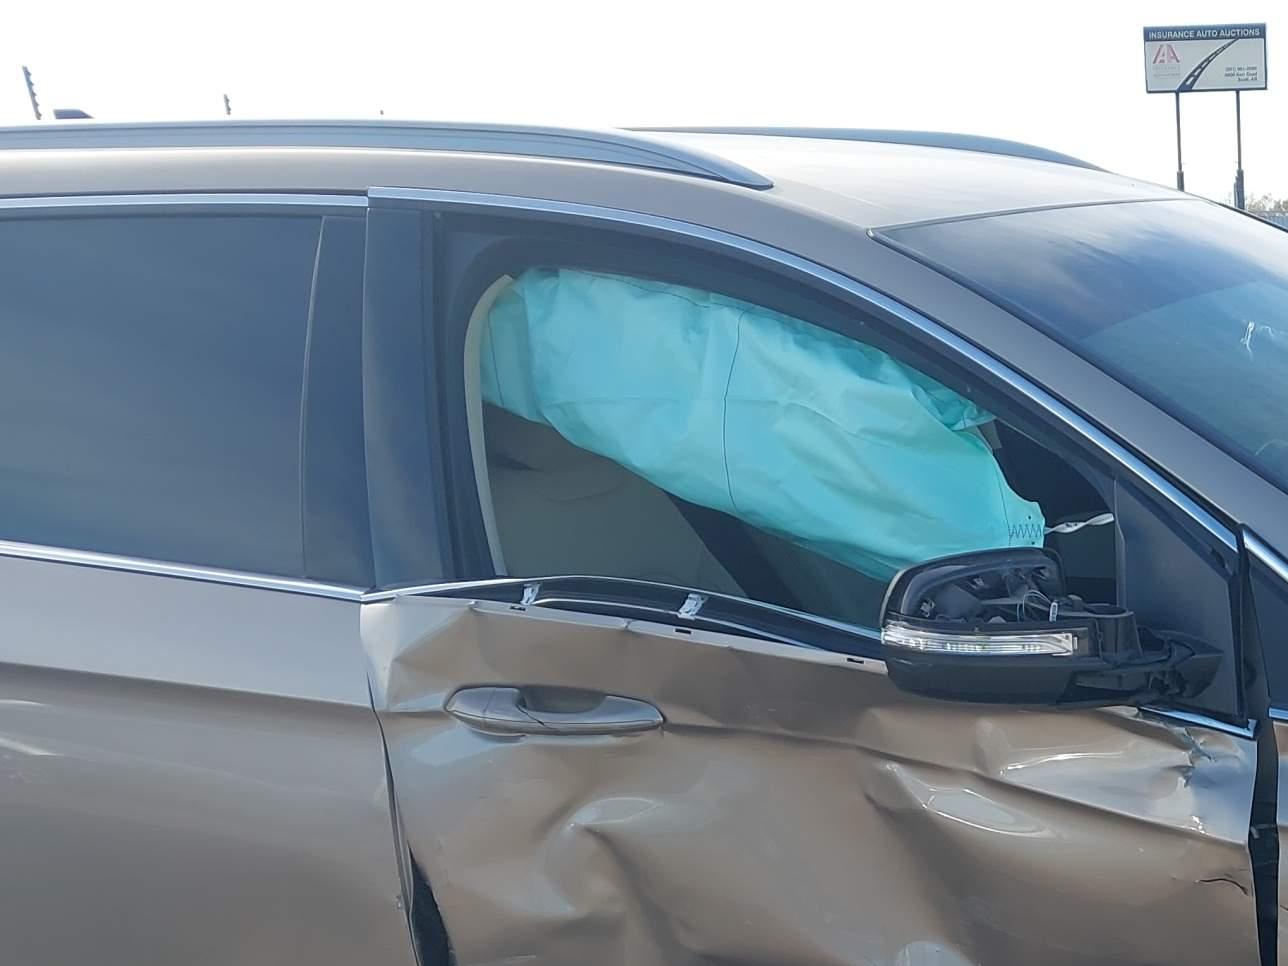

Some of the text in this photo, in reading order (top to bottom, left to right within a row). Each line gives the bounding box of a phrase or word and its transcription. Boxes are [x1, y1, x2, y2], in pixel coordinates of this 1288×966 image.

[1149, 28, 1260, 39] INSURANCE AUTO AUCTIONS
